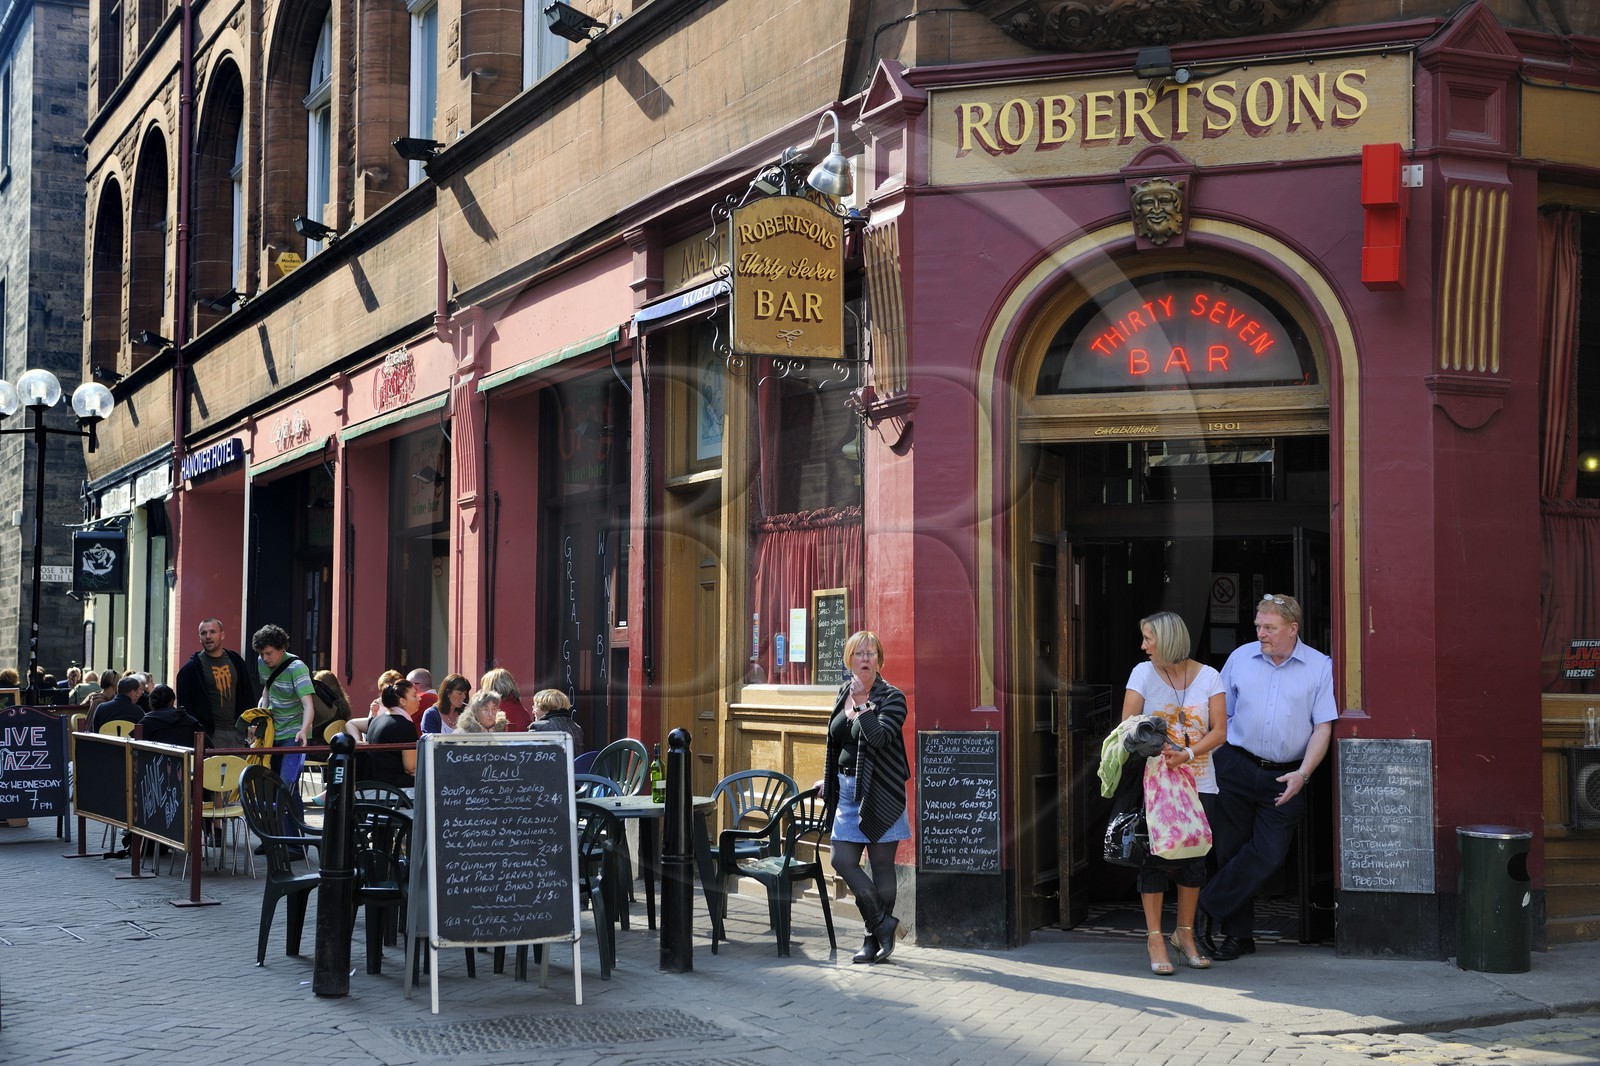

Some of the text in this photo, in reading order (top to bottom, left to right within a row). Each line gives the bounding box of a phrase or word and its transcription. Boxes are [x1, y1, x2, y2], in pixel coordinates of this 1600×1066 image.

[956, 70, 1368, 157] ROBERTSONS
[738, 214, 838, 250] ROBERTSONS
[738, 252, 838, 281] Thirty Seven
[754, 289, 823, 325] BAR
[1091, 293, 1275, 358] THIRTY SEVEN
[1130, 345, 1230, 375] BAR
[1094, 421, 1241, 437] Established 1901
[181, 439, 235, 481] HANOVER HOTEL
[41, 573, 63, 581] ORTH
[564, 536, 581, 641] GREAT
[1572, 640, 1600, 648] WATCH
[1565, 648, 1600, 660] LIVE
[596, 634, 610, 706] BA
[1566, 669, 1595, 677] HERE
[926, 736, 940, 746] LIVE
[941, 735, 962, 745] SPORT
[983, 737, 995, 746] TWO
[937, 744, 961, 753] PLASMA
[962, 745, 995, 754] SCREENS
[446, 750, 556, 765] ROBERTSONS 37 BAR
[923, 755, 943, 763] TODAY
[481, 764, 520, 779] MENU
[923, 766, 937, 774] KICK
[11, 779, 62, 789] WEDNESDAY
[924, 776, 994, 787] SOUP OF THE DAY
[441, 786, 465, 796] SOUP
[479, 786, 495, 795] THE
[499, 786, 514, 795] DAY
[1354, 784, 1406, 795] RANGERS
[24, 789, 39, 810] 7
[40, 802, 53, 810] PM
[443, 798, 462, 806] WITH
[926, 799, 993, 809] VARIOUS TOASTED
[1352, 801, 1369, 813] ST
[452, 817, 498, 827] SELECTION
[516, 815, 559, 824] FRESHLY
[923, 809, 973, 822] SANDWICHES
[442, 829, 458, 839] CUT
[924, 826, 983, 835] A SELECTION OF
[466, 840, 488, 848] MENU
[508, 838, 544, 847] DETAILS
[923, 836, 986, 845] BUTCHERS MEAT
[1346, 838, 1402, 849] TOTTENHAM
[924, 845, 938, 854] PIES
[942, 846, 956, 854] WITH
[971, 845, 998, 855] WITHOUT
[445, 861, 459, 870] TOP
[461, 860, 497, 871] QUALITY
[926, 856, 949, 866] BAKED
[950, 856, 974, 866] BEANS
[1348, 859, 1410, 869] BIRMINGHAM
[446, 870, 557, 884] MEAT PIES SERVED WITH
[1352, 874, 1398, 886] PRESTON
[447, 879, 568, 895] OR WITHOUT BAKED BEANS
[495, 893, 516, 903] FROM
[444, 912, 553, 927] TEA COFFEE SERVED
[472, 925, 523, 937] ALL DAY
